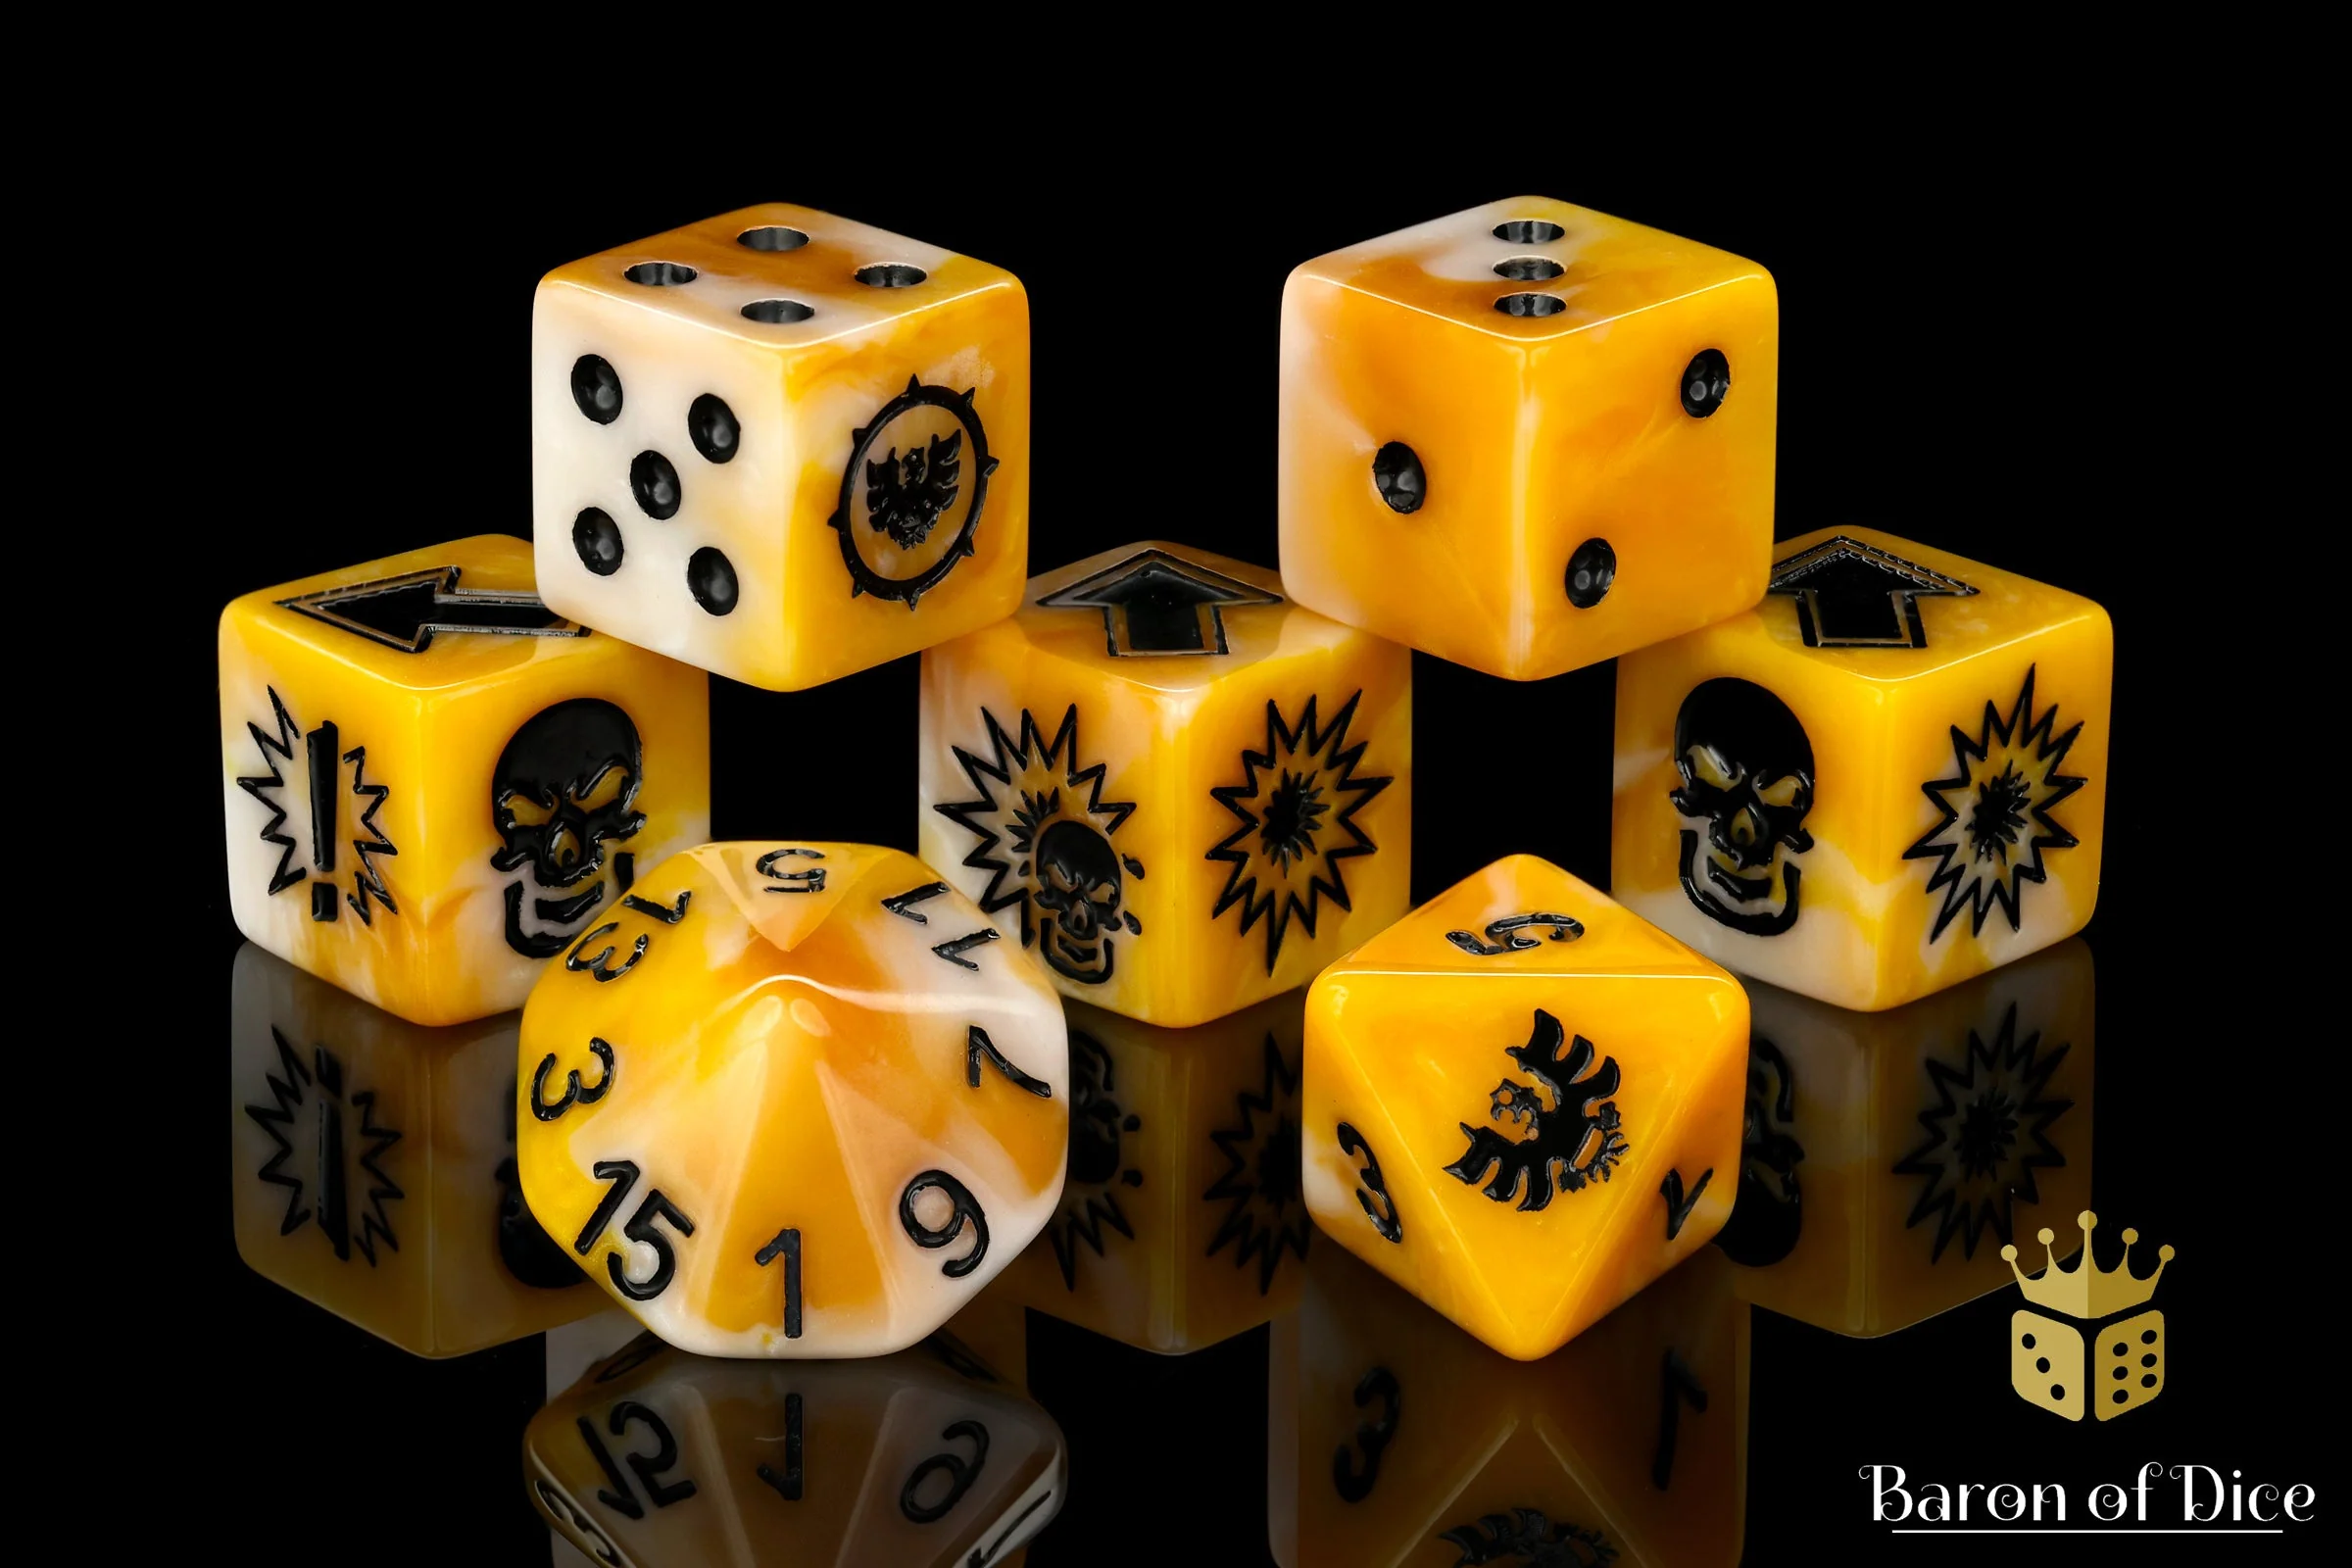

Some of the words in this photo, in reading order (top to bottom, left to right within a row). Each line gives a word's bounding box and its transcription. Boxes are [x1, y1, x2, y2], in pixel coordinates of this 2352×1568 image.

[755, 849, 826, 893] 5
[530, 1036, 615, 1122] 3
[966, 1025, 1053, 1099] 7
[573, 1159, 696, 1301] 15
[899, 1168, 991, 1278] 9
[754, 1228, 803, 1339] 1
